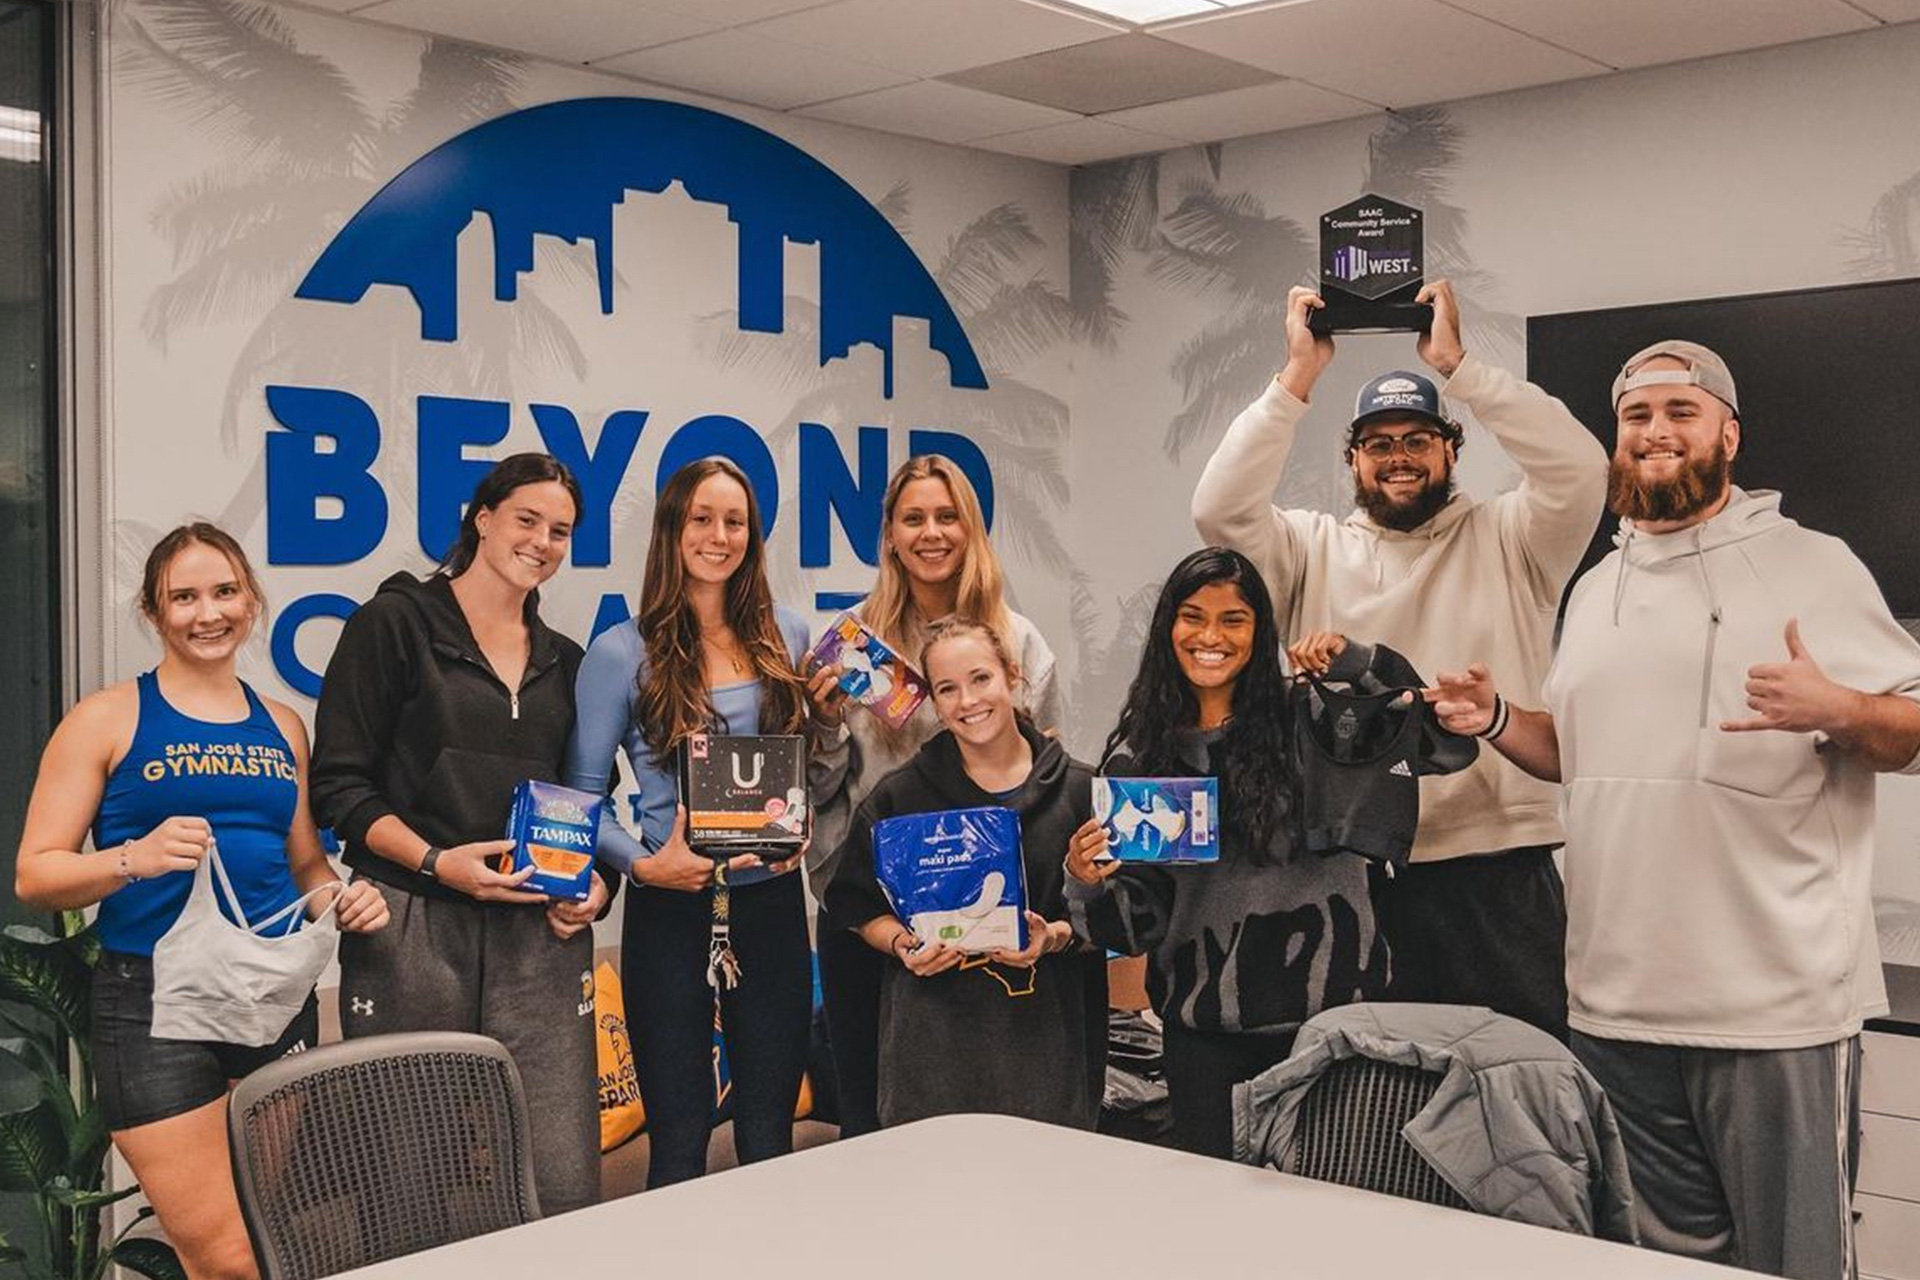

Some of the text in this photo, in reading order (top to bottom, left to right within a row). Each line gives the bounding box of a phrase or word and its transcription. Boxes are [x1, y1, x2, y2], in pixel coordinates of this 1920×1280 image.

[1358, 208, 1383, 217] SAAC
[1331, 217, 1411, 229] Community Service
[1357, 229, 1385, 237] Award
[1368, 258, 1411, 274] WEST
[165, 743, 200, 757] SAN
[530, 825, 592, 847] TAMPAX
[918, 850, 972, 867] maxi pads
[598, 1064, 637, 1091] AN JOS
[599, 1081, 641, 1110] SPAR
